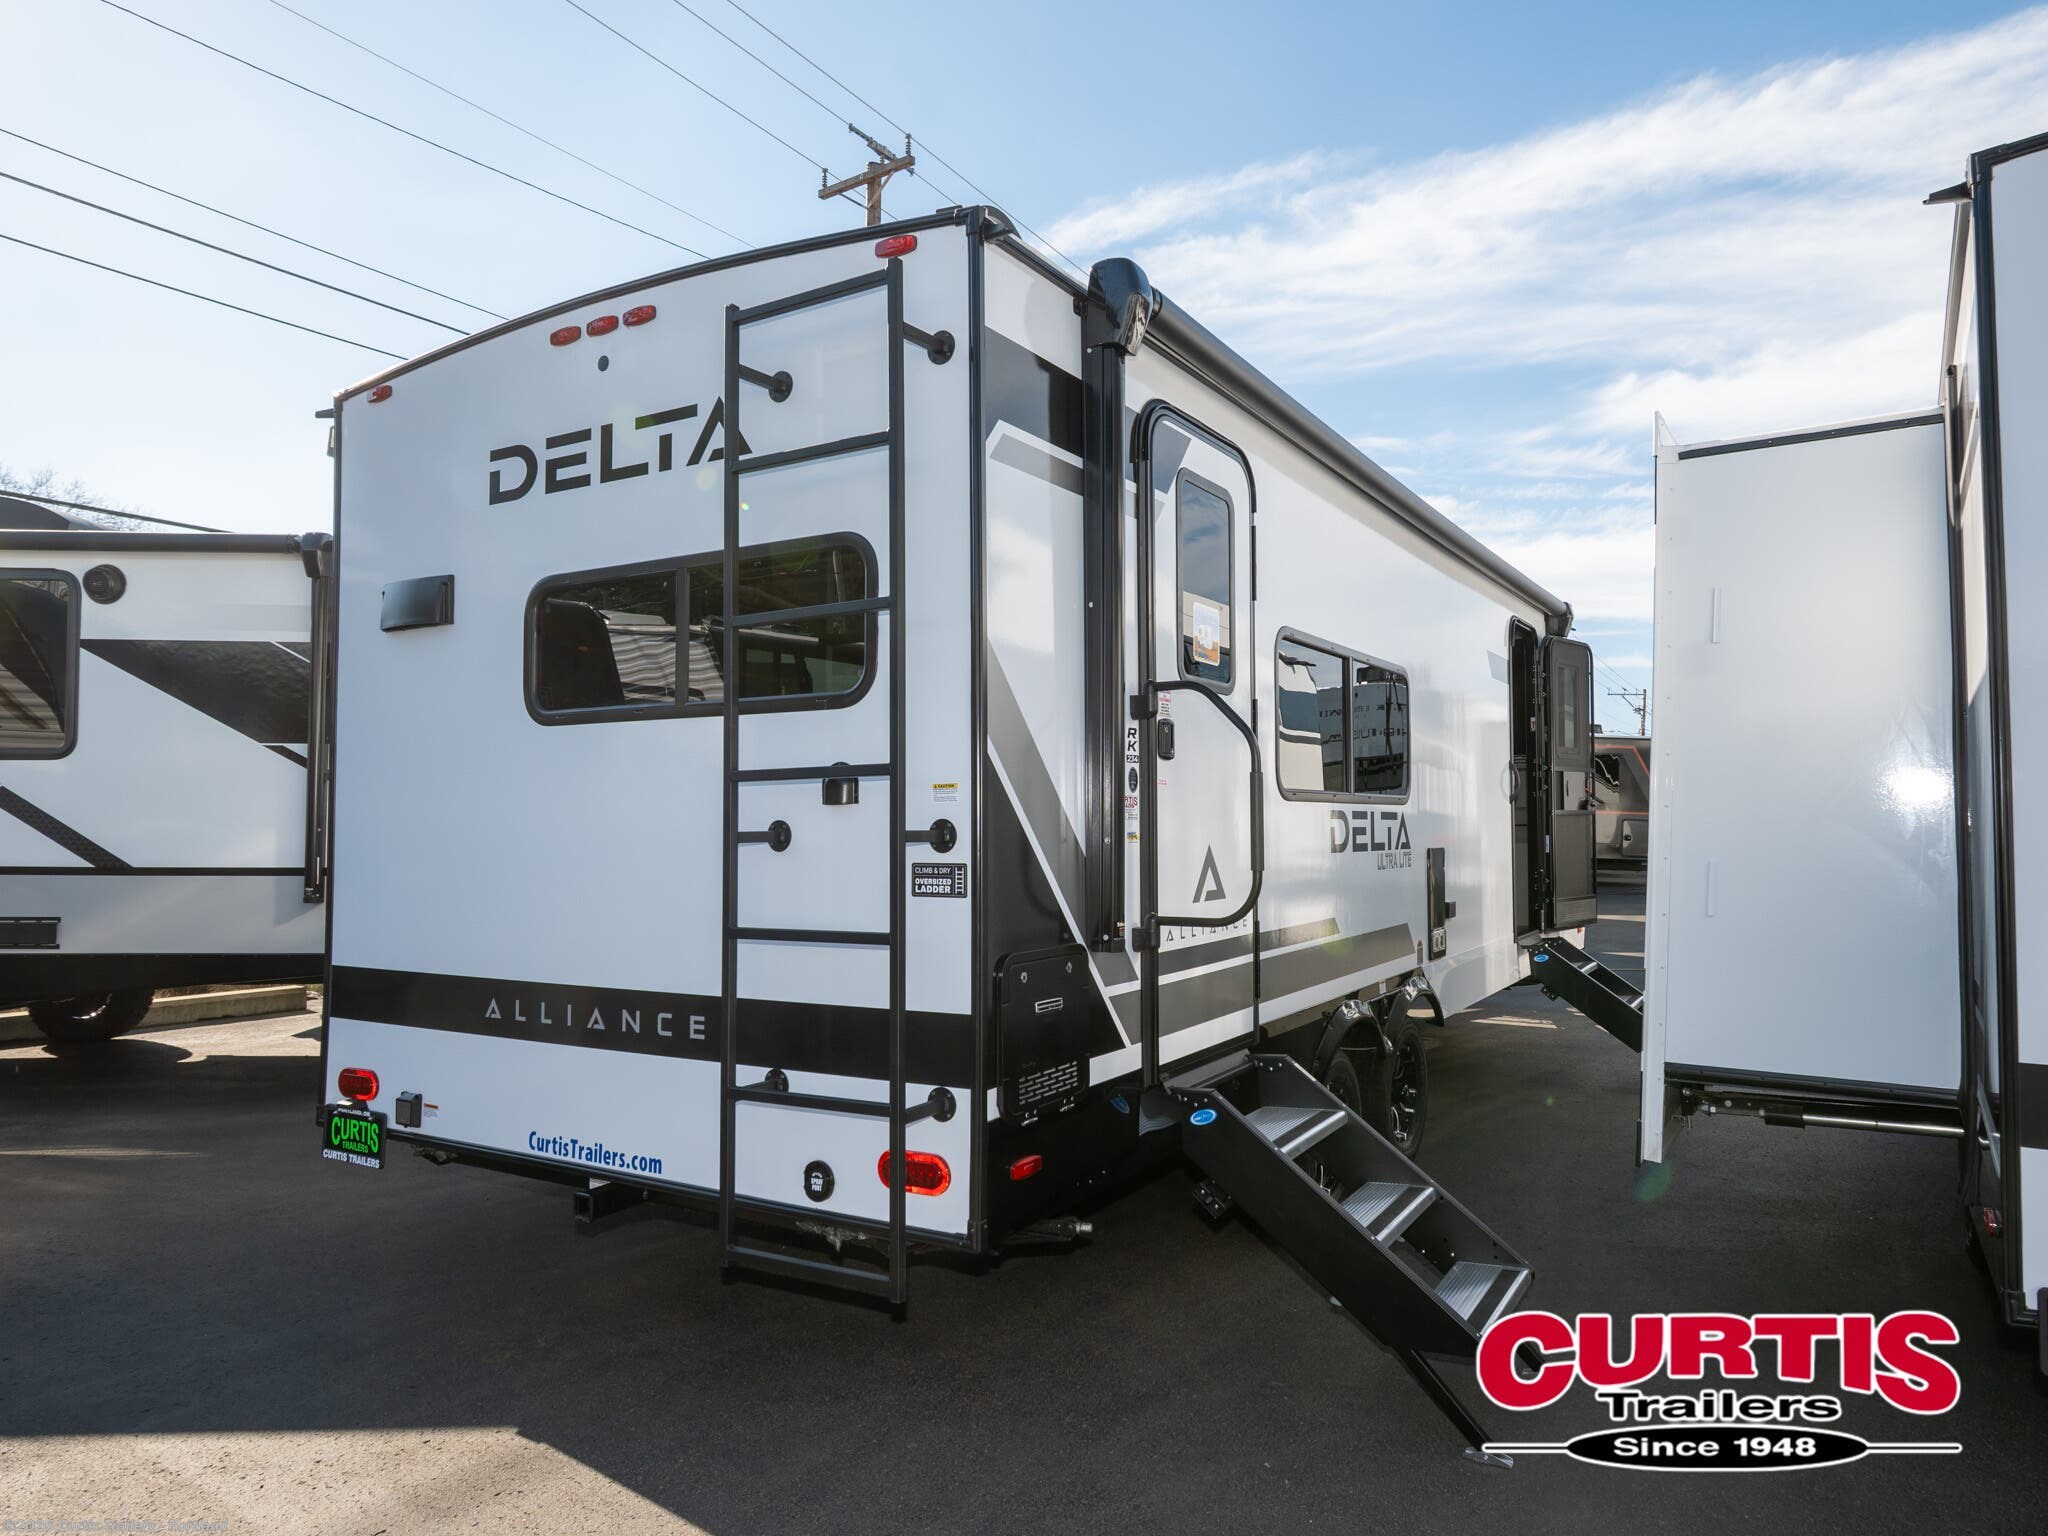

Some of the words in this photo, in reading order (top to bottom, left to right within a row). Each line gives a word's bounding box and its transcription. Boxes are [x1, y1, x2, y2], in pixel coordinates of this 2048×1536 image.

[489, 396, 752, 505] DELTA
[1330, 810, 1411, 853] DELTA
[1377, 851, 1398, 871] ULTRA
[1399, 850, 1412, 869] LITE
[915, 885, 951, 894] LADDER
[484, 998, 706, 1040] ALLIANCE
[331, 1116, 379, 1153] CURTIS
[342, 1141, 369, 1153] TRAILERS
[528, 1130, 663, 1175] CurtisTrailers.com
[323, 1149, 348, 1162] CURTIS
[348, 1154, 380, 1169] TRAILERS
